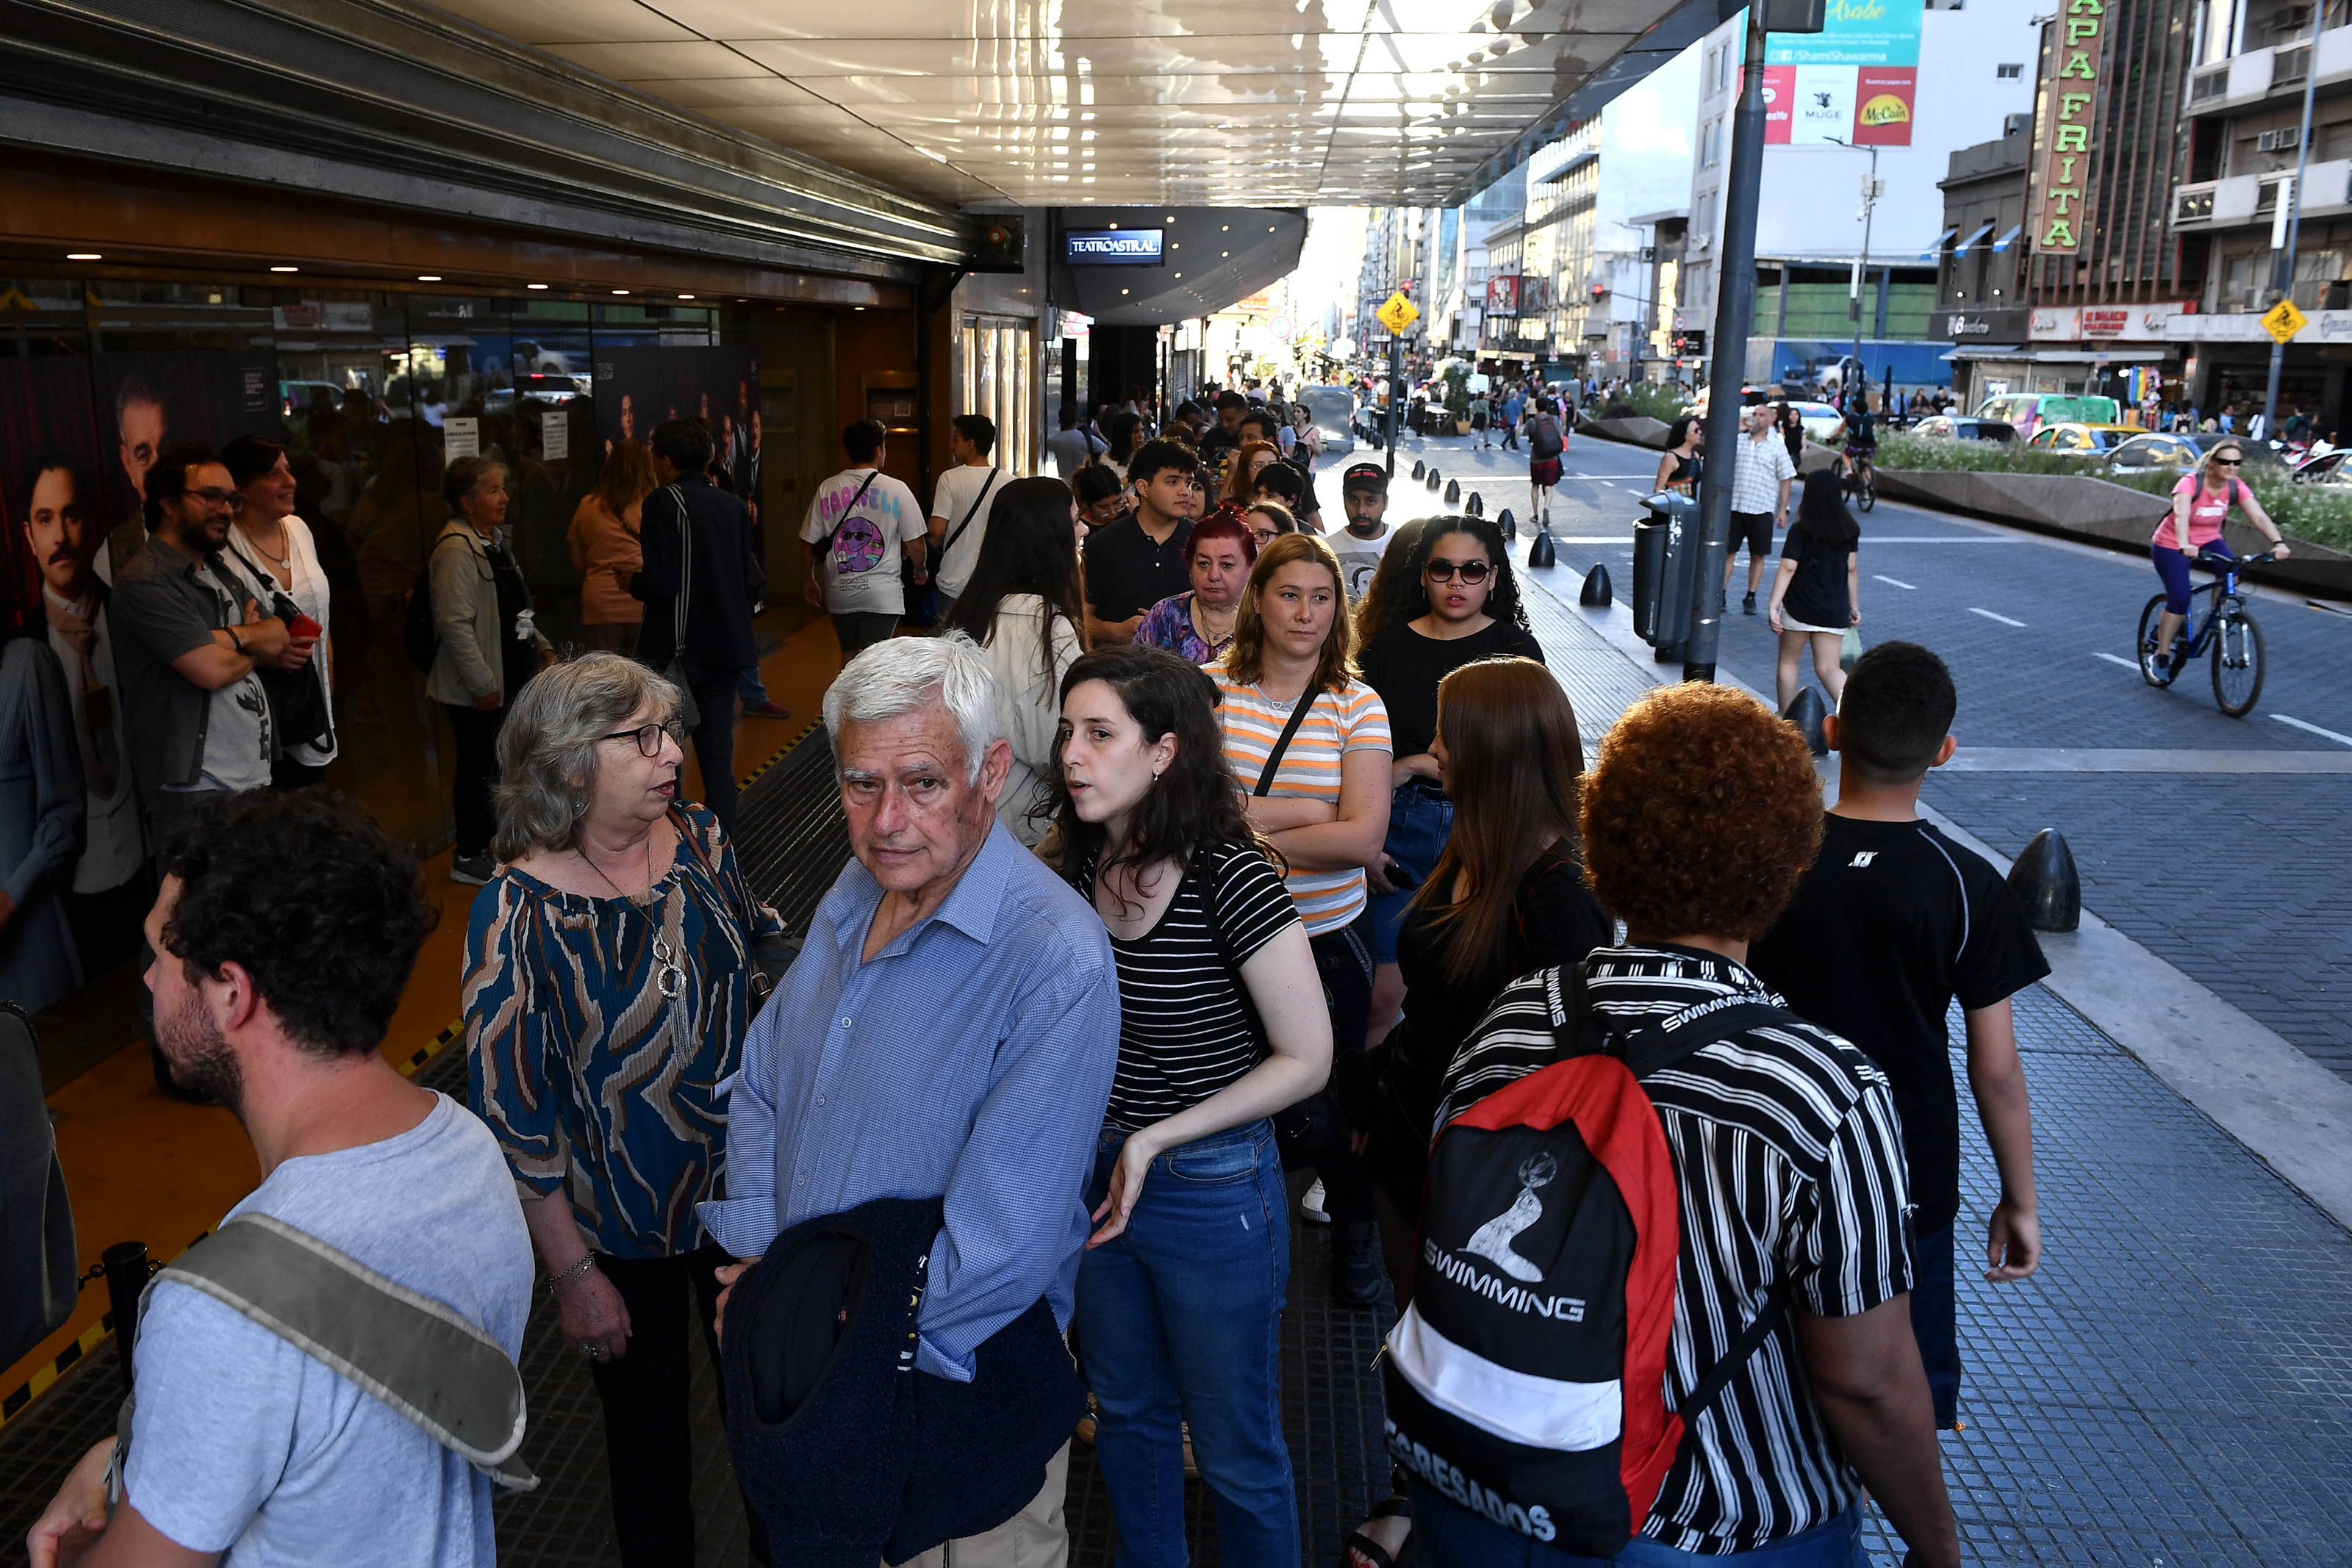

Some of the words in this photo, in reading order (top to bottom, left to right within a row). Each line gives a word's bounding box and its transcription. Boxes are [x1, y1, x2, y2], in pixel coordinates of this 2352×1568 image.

[1806, 109, 1841, 119] MUGE
[1865, 106, 1905, 121] McCain
[2041, 92, 2091, 247] FRITA
[1661, 994, 1770, 1033] SWIMMIN
[1424, 1237, 1586, 1323] SWIMMING
